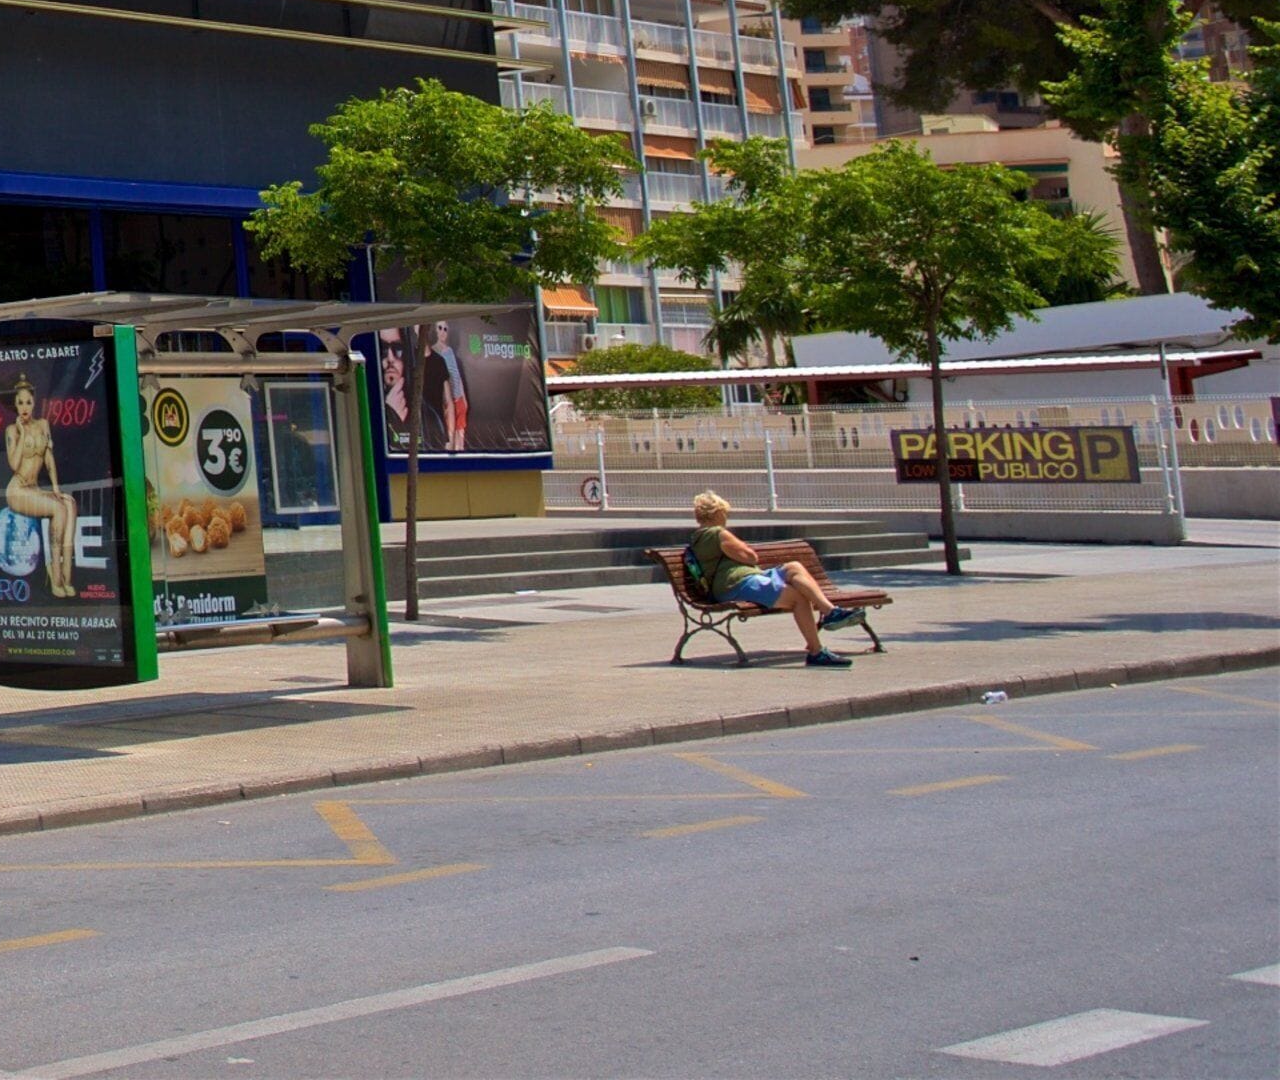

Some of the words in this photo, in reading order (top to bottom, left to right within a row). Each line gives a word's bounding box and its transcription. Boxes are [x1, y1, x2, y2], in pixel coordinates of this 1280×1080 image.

[37, 345, 80, 359] CABARET
[899, 431, 1076, 461] PARKING
[980, 462, 1078, 480] PUBLICO
[10, 616, 48, 627] RECINTO
[51, 617, 79, 627] FERIAL
[81, 617, 117, 628] RABASA
[2, 629, 16, 639] DEL
[26, 630, 36, 639] AL
[47, 631, 56, 640] DE
[57, 631, 79, 641] MAYO
